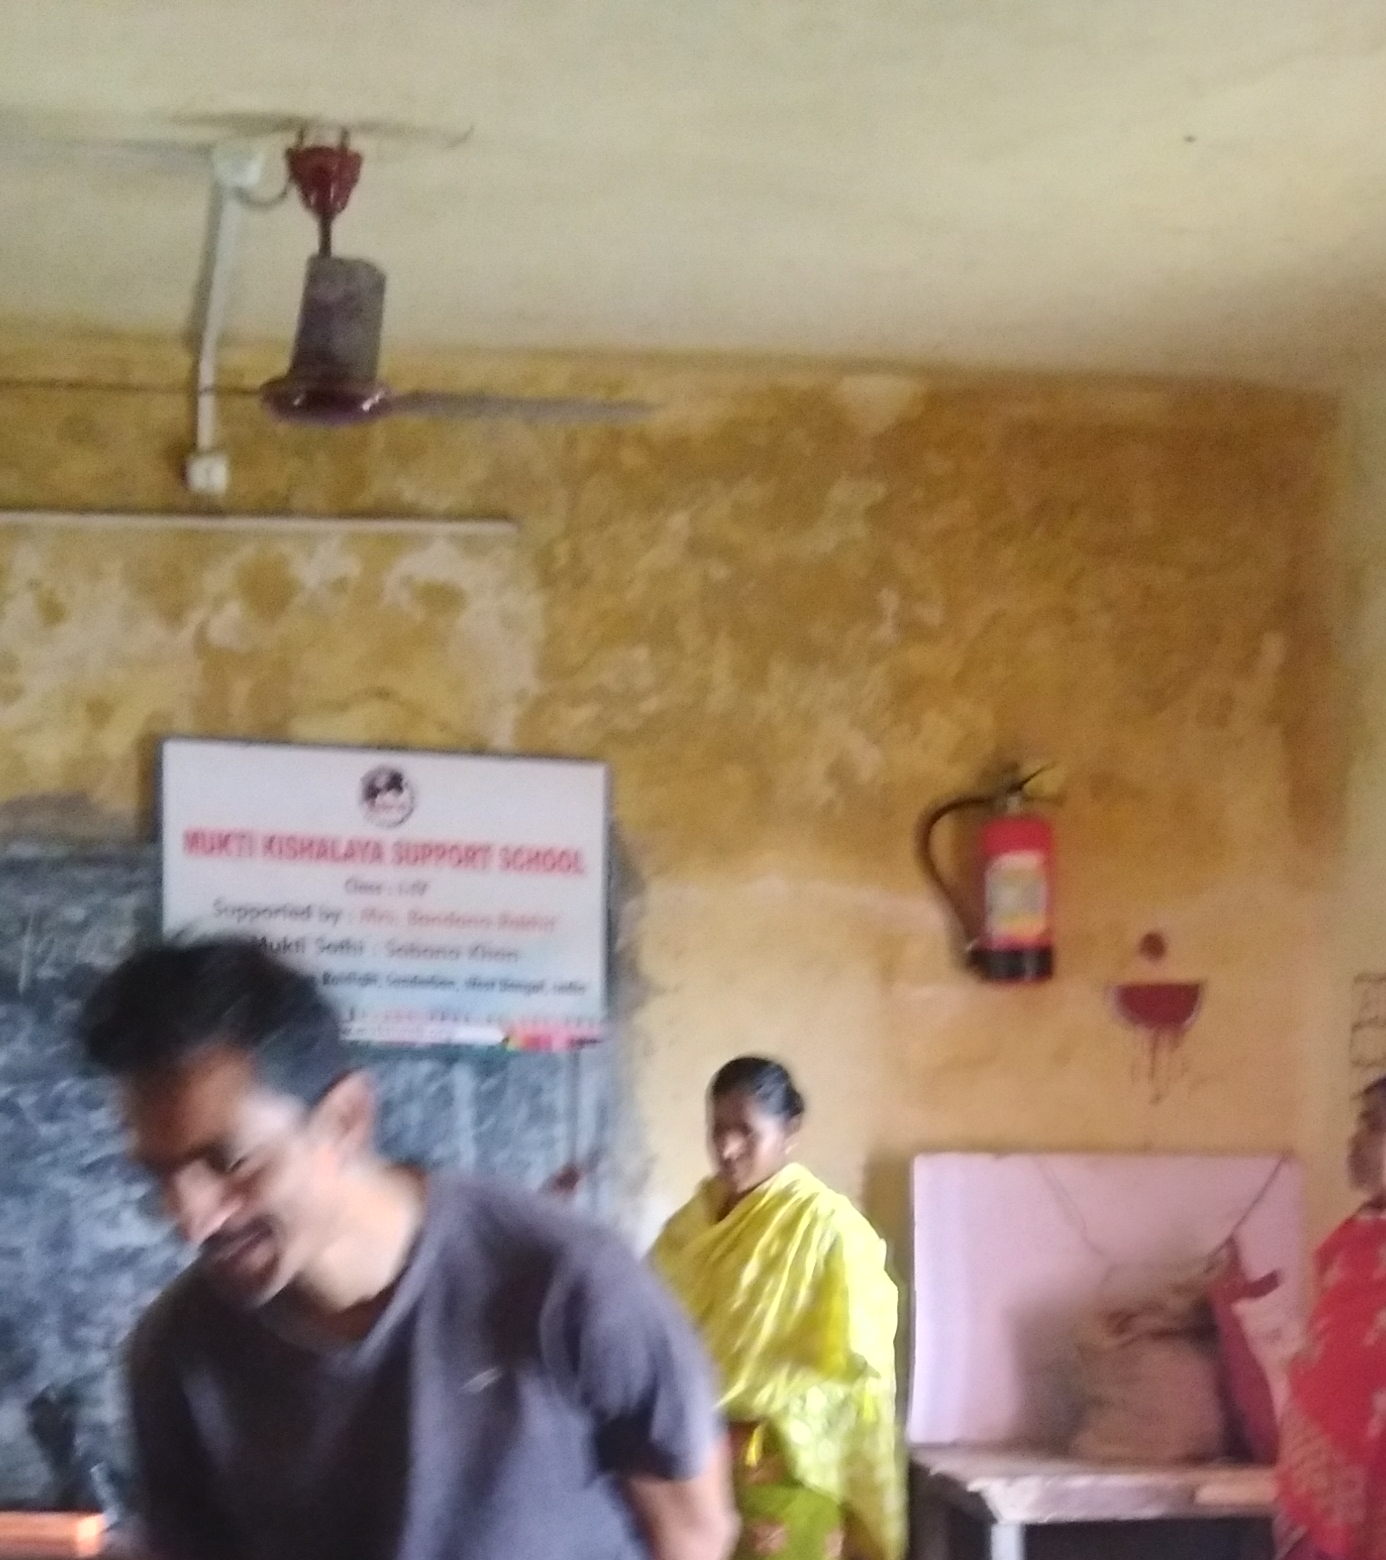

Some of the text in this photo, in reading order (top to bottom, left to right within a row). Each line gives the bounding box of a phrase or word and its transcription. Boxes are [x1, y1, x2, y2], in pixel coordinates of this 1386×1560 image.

[184, 828, 586, 876] MUKTI KISHALAYA SUPPORT SCHOOL
[213, 898, 312, 927] Supported
[318, 903, 343, 928] by
